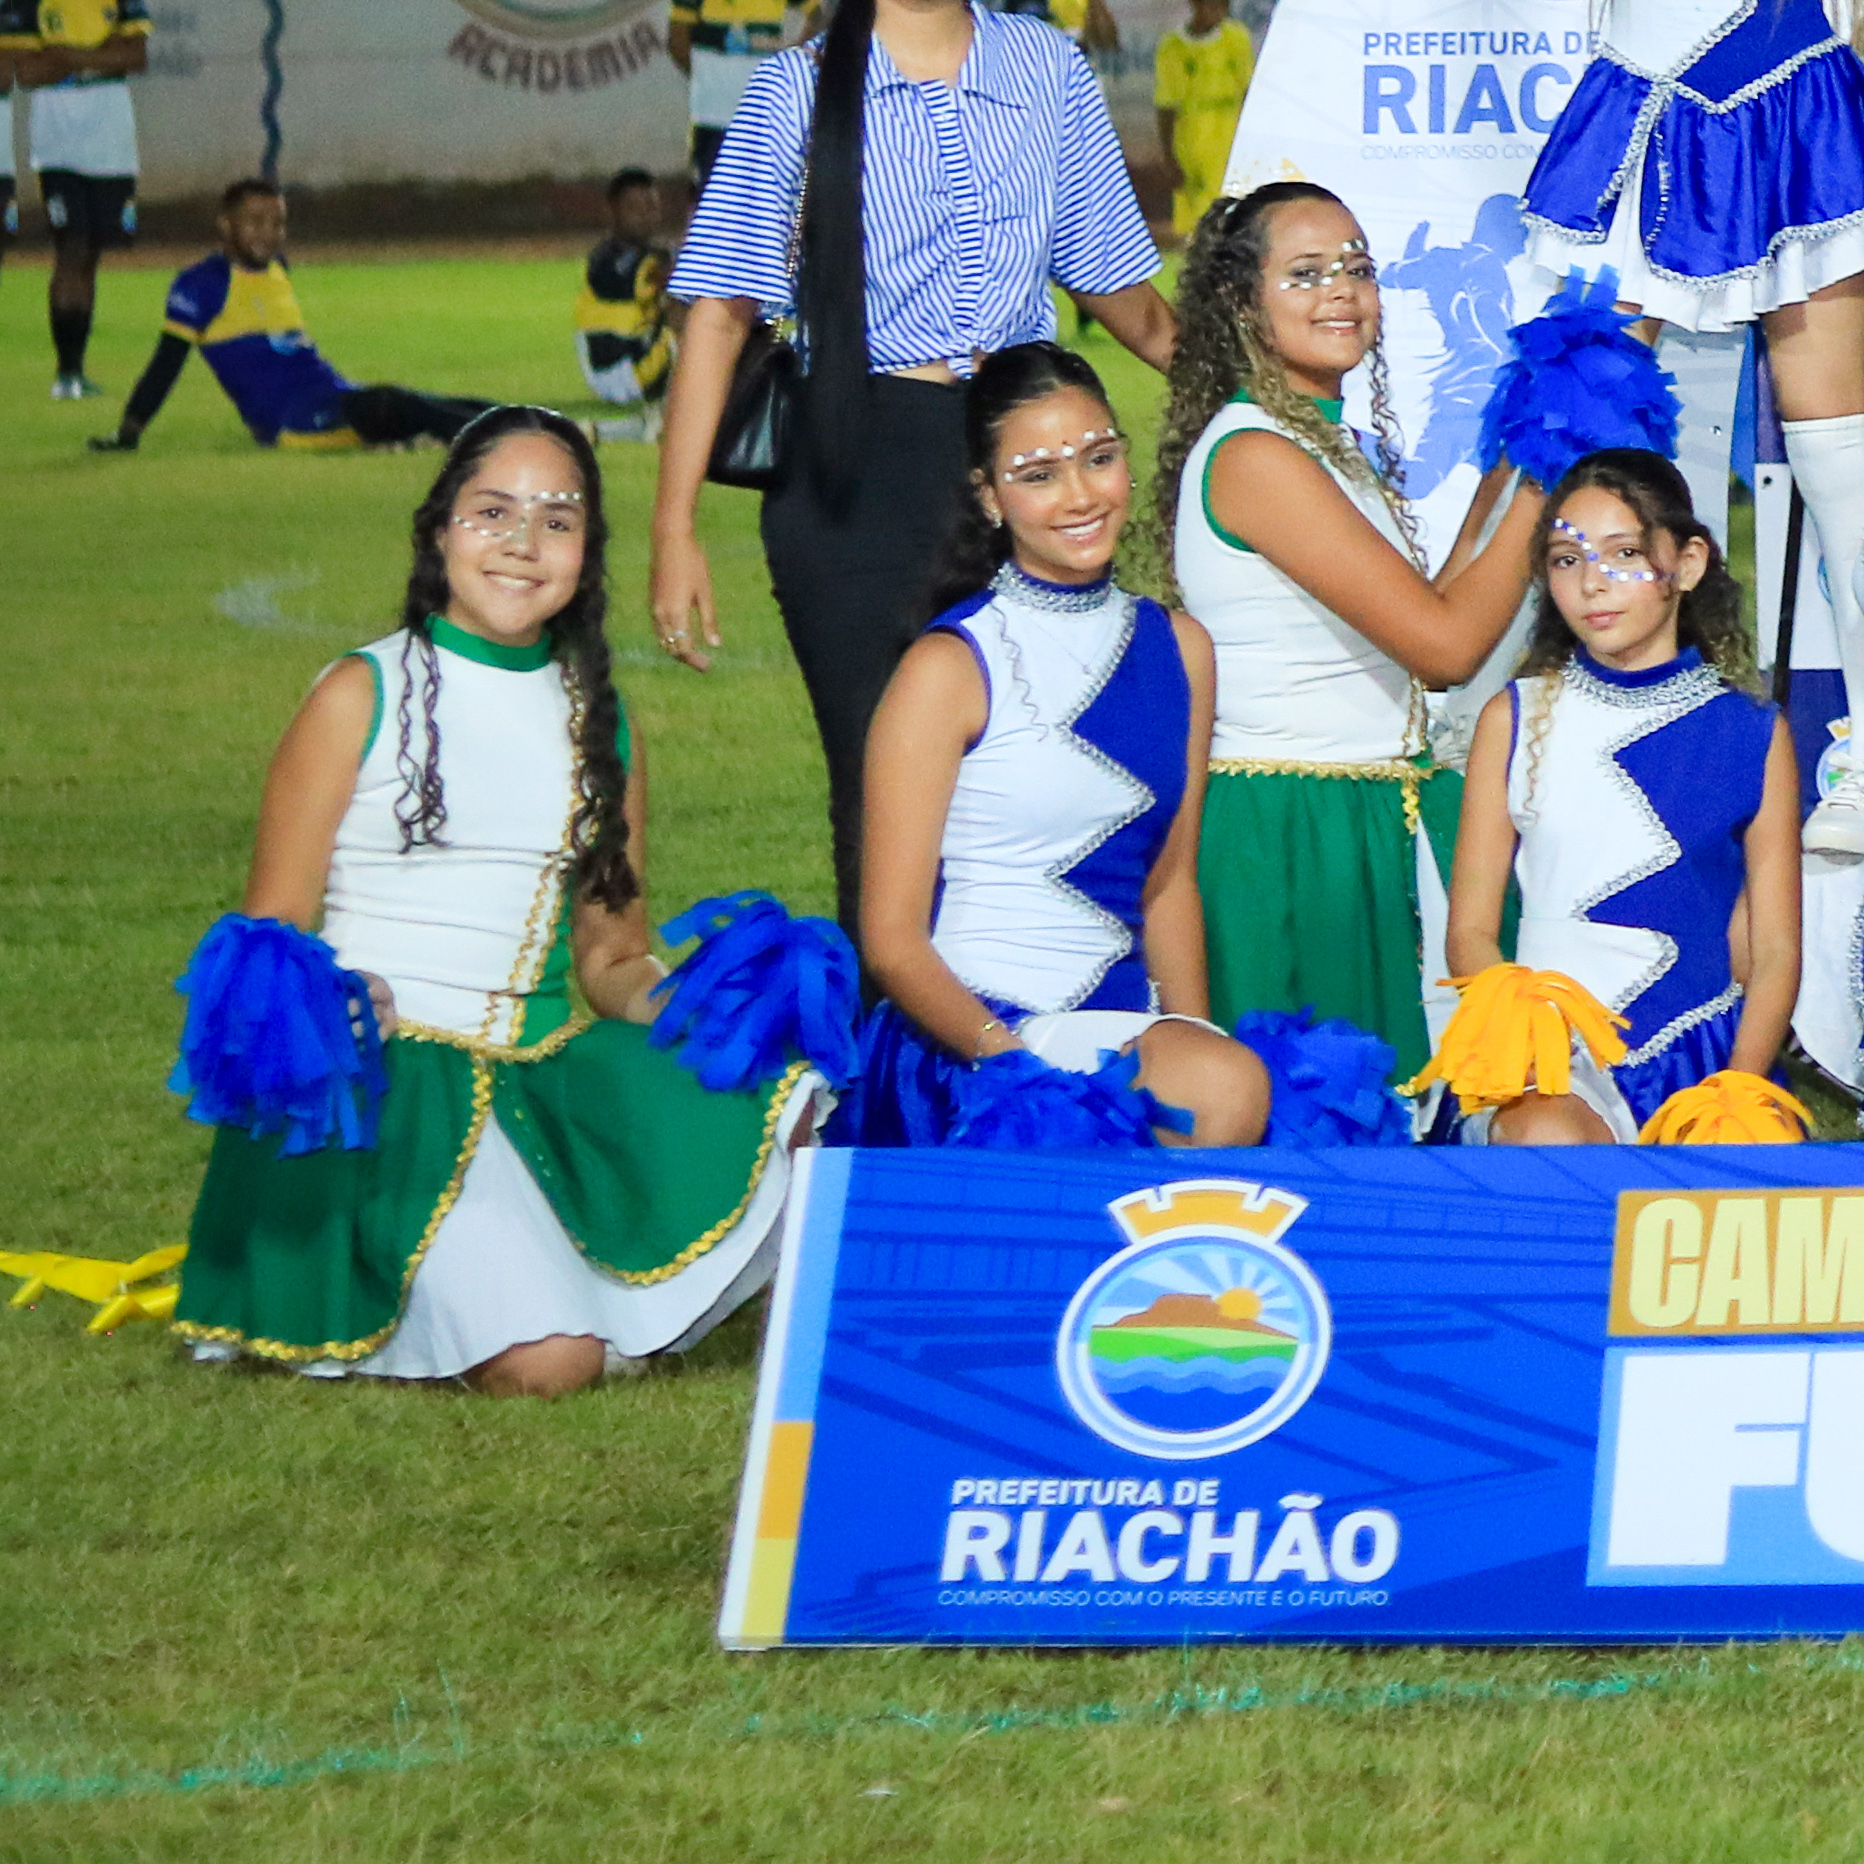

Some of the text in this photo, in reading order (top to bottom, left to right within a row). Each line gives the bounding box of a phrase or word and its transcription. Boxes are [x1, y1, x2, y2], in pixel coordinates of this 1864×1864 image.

[447, 20, 662, 92] ACADEMIA
[1363, 31, 1551, 56] PREFEITURA
[1362, 62, 1592, 134] RIAC
[1360, 144, 1497, 160] COMPROMISSO
[951, 1479, 1220, 1506] PREFEITURA DE
[940, 1493, 1401, 1583] RIACHÃO
[938, 1589, 1090, 1607] COMPROMISSO
[1096, 1589, 1143, 1607] COM
[1147, 1589, 1163, 1606] O
[1168, 1589, 1265, 1606] PRESENTE
[1271, 1589, 1283, 1606] E
[1288, 1589, 1304, 1606] O
